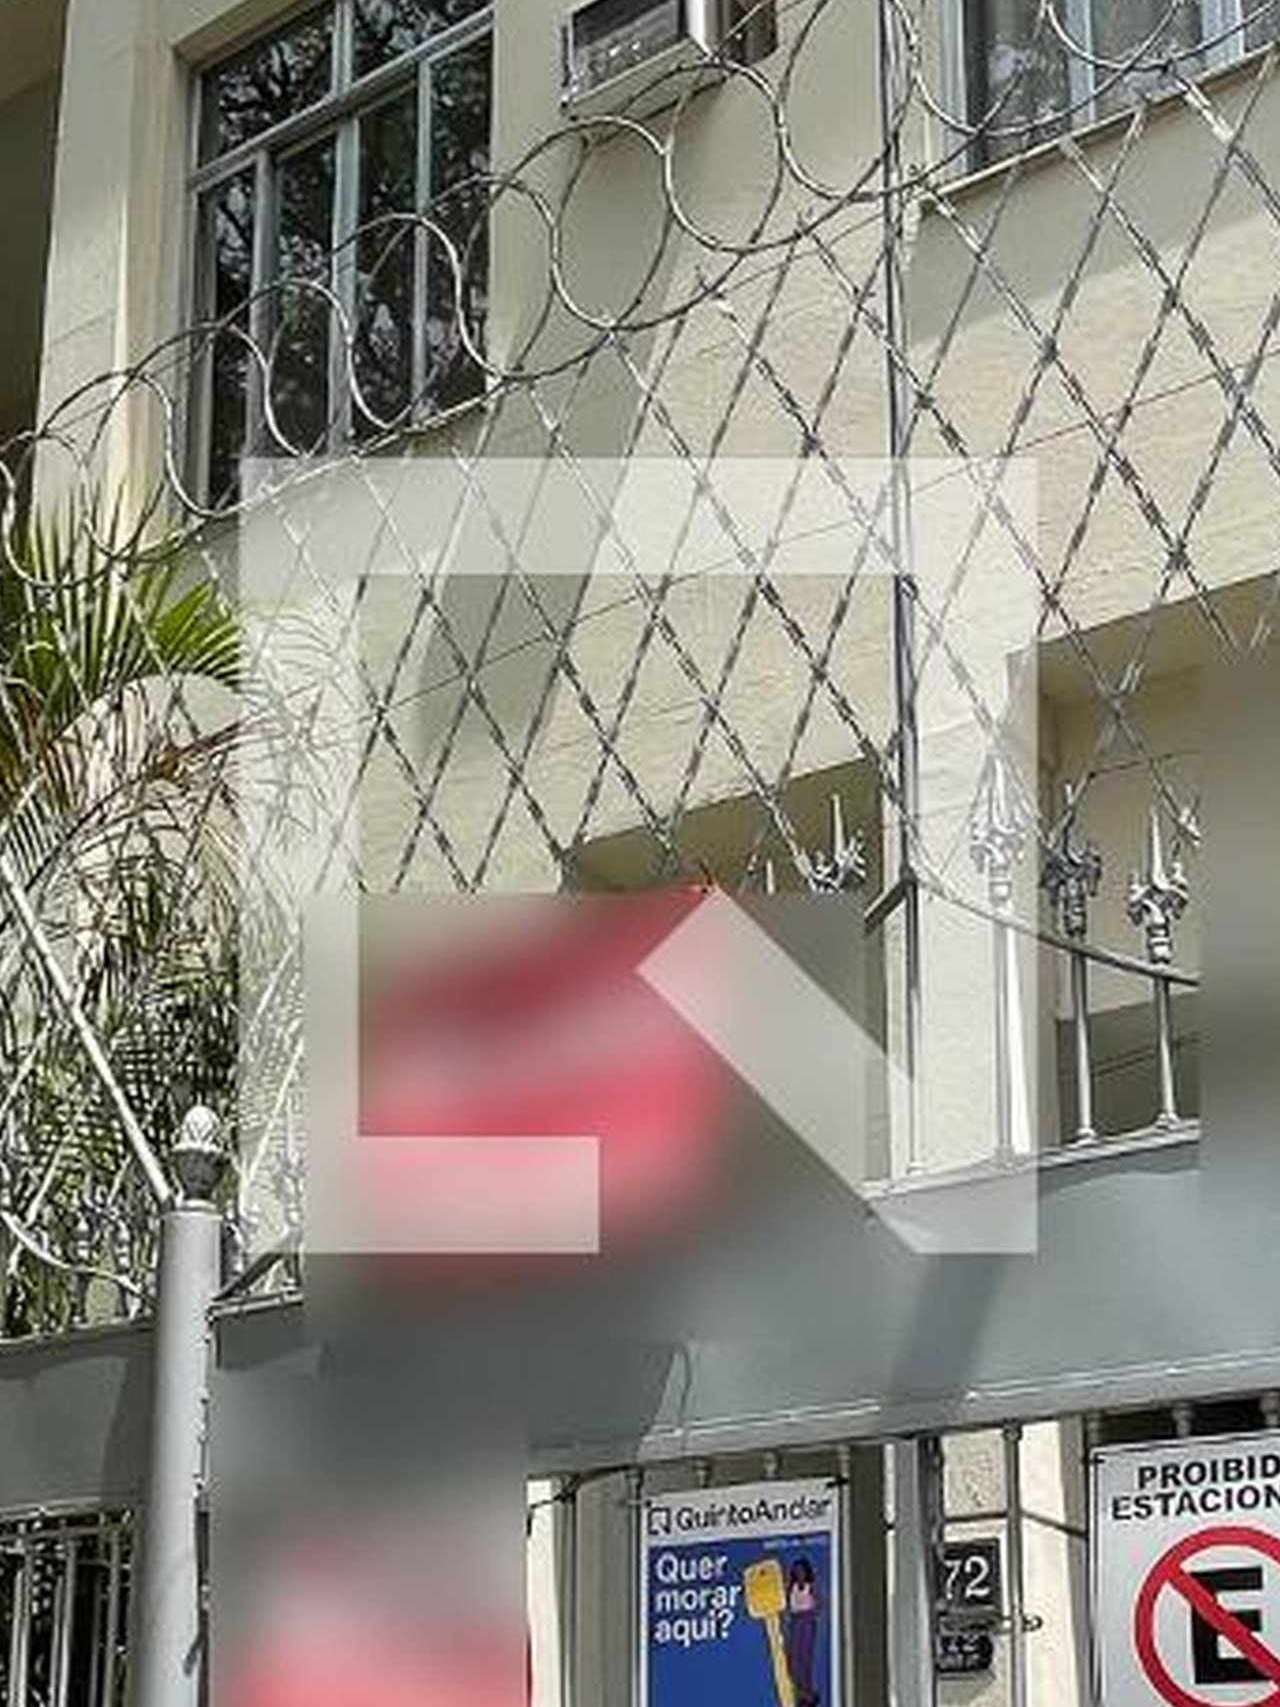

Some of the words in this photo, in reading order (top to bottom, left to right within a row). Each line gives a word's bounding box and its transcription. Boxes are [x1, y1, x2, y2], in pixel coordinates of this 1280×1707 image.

[676, 1496, 831, 1531] QuintoAndar
[655, 1551, 728, 1583] Quer
[655, 1585, 742, 1611] morar
[654, 1609, 735, 1647] aqui?
[1187, 1566, 1274, 1685] E
